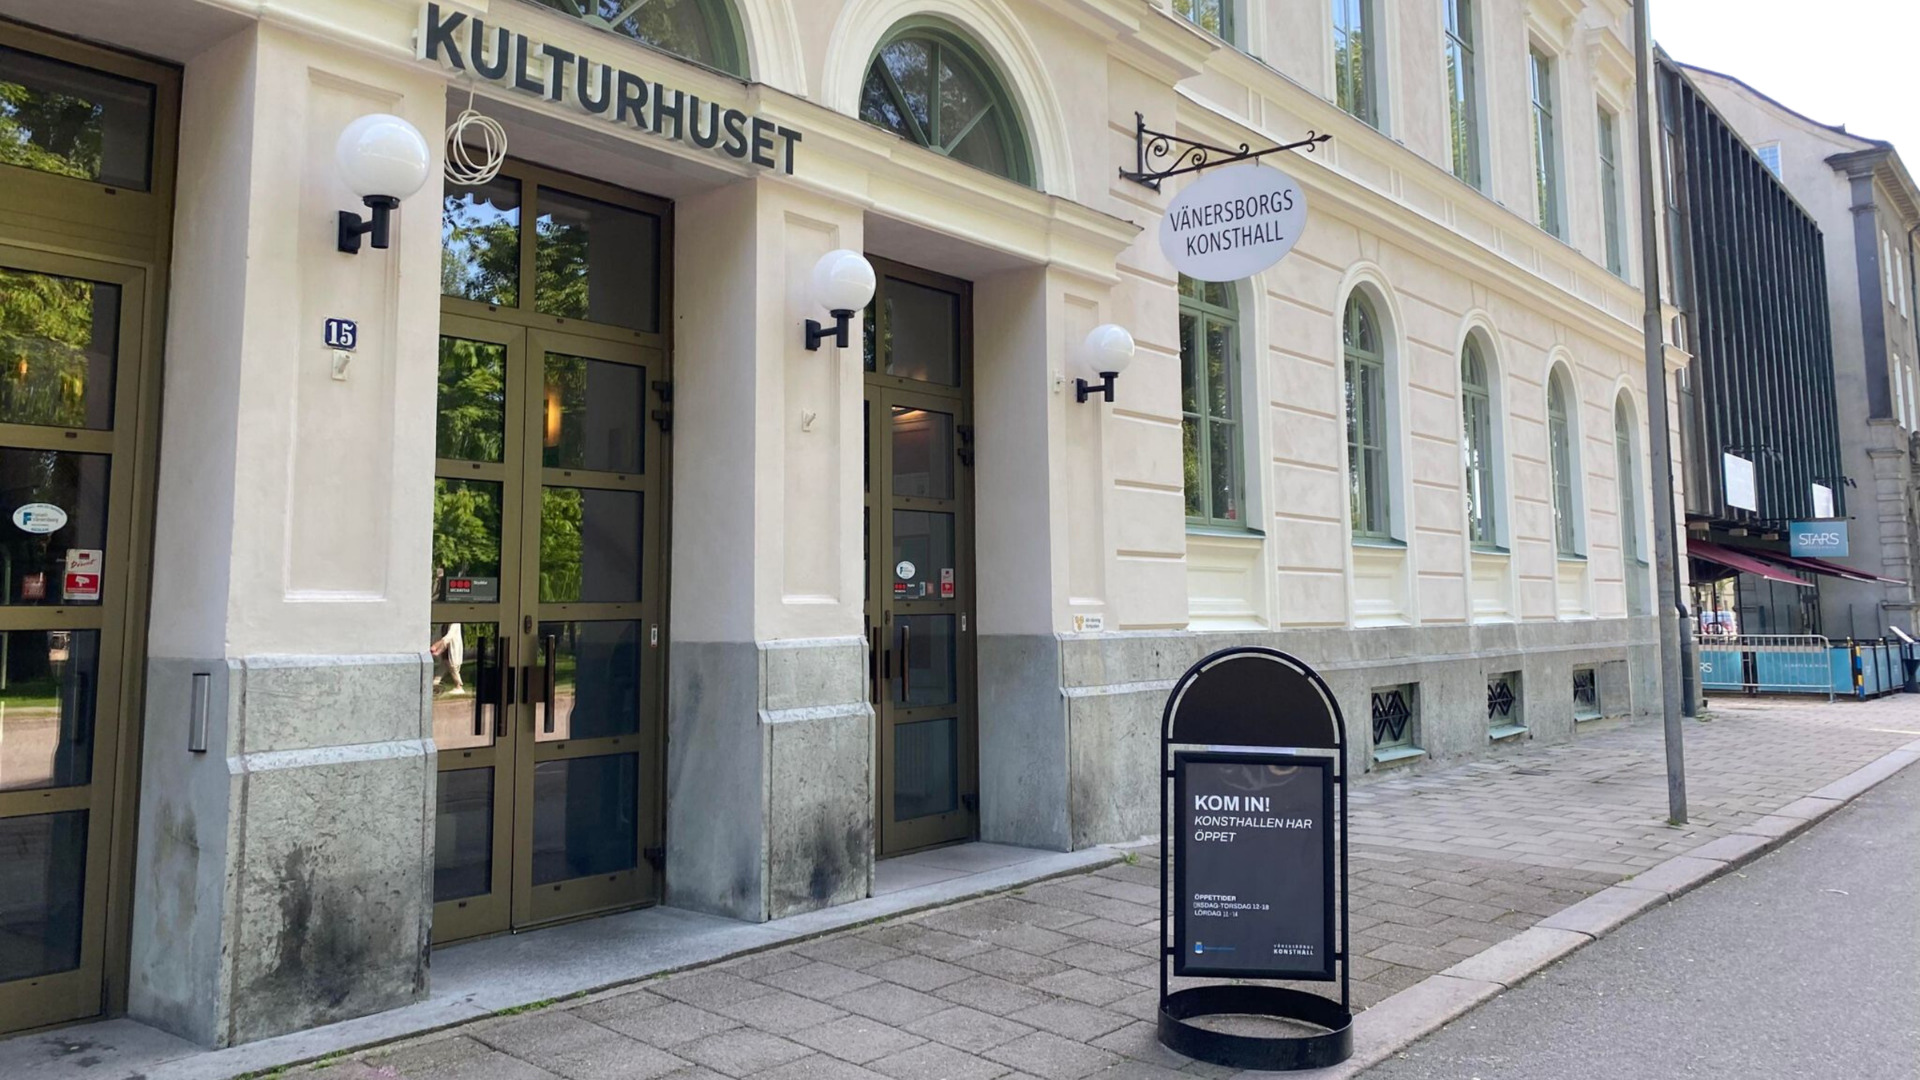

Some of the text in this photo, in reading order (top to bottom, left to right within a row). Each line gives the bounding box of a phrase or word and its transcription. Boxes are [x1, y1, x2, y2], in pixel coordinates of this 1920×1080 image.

[425, 2, 802, 175] KULTURHUSET
[1170, 189, 1293, 232] VÄNERSBORGS
[1186, 220, 1284, 257] KONSTHALL
[328, 321, 354, 346] 15
[1799, 532, 1840, 546] STARS
[1194, 795, 1270, 812] KOM IN!
[1194, 815, 1313, 829] KONSTHALLEN HAR
[1194, 829, 1237, 842] ÖPPET
[1194, 893, 1237, 902] ÖPPETTIDER
[1194, 909, 1222, 917] LÖRDAG
[1273, 948, 1314, 956] KONSTHALL
